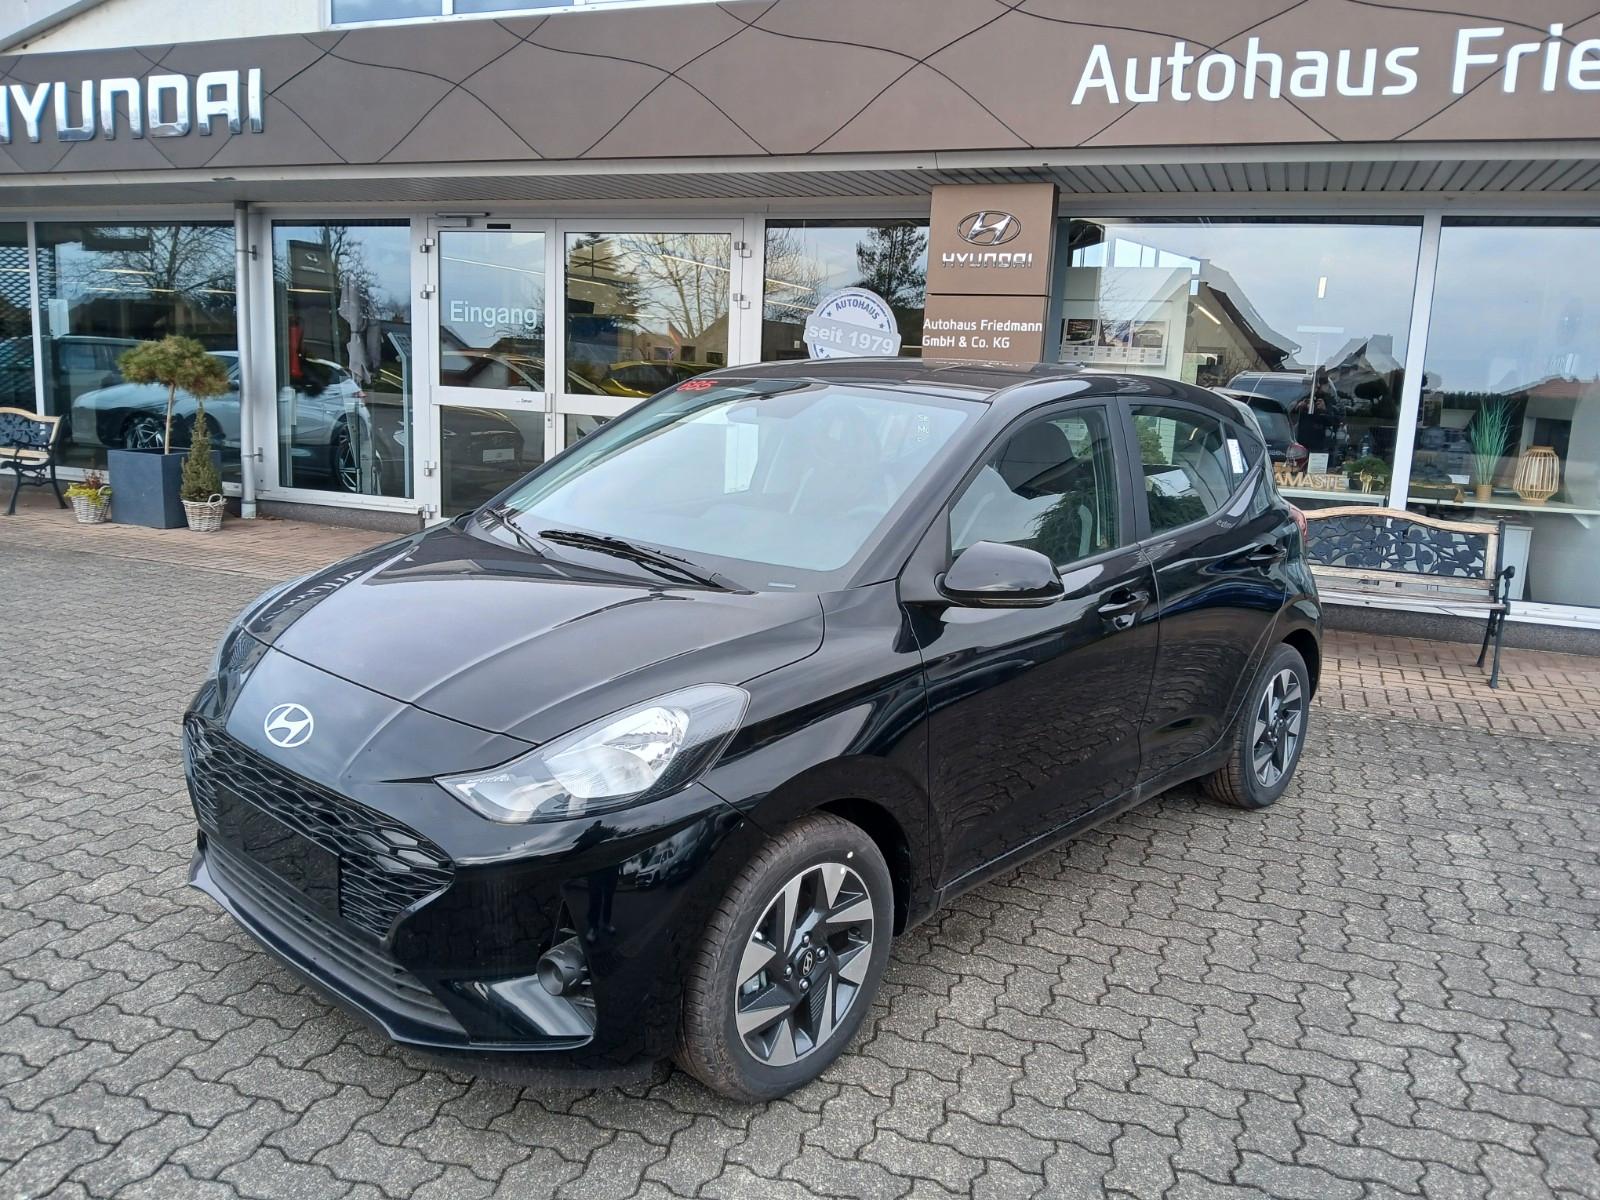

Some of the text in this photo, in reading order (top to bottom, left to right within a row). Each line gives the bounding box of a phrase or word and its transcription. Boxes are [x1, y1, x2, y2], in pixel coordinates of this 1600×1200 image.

[1071, 37, 1420, 105] Autohaus
[0, 68, 264, 144] YUNDAI
[942, 252, 1033, 268] HYUNDAI
[450, 300, 538, 329] Eingang
[835, 298, 880, 320] AUTOHAUS
[923, 318, 1043, 332] Autohaus Friedmann
[808, 324, 894, 354] seit 1979
[922, 335, 1010, 348] GmbH & Co. KG
